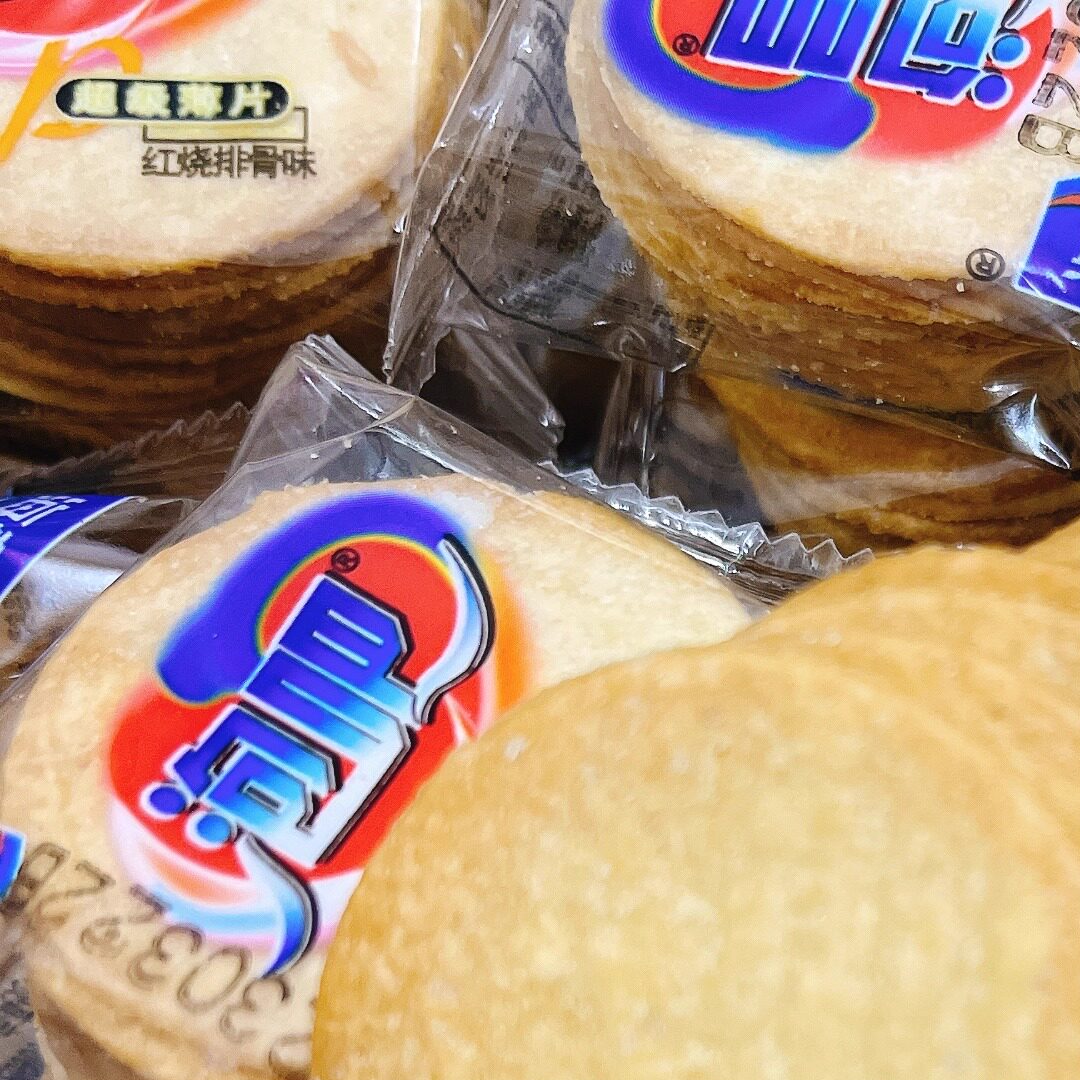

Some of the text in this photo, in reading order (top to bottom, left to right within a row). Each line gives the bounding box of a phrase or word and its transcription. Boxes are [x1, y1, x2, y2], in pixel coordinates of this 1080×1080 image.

[141, 145, 318, 179] 红烧排骨味
